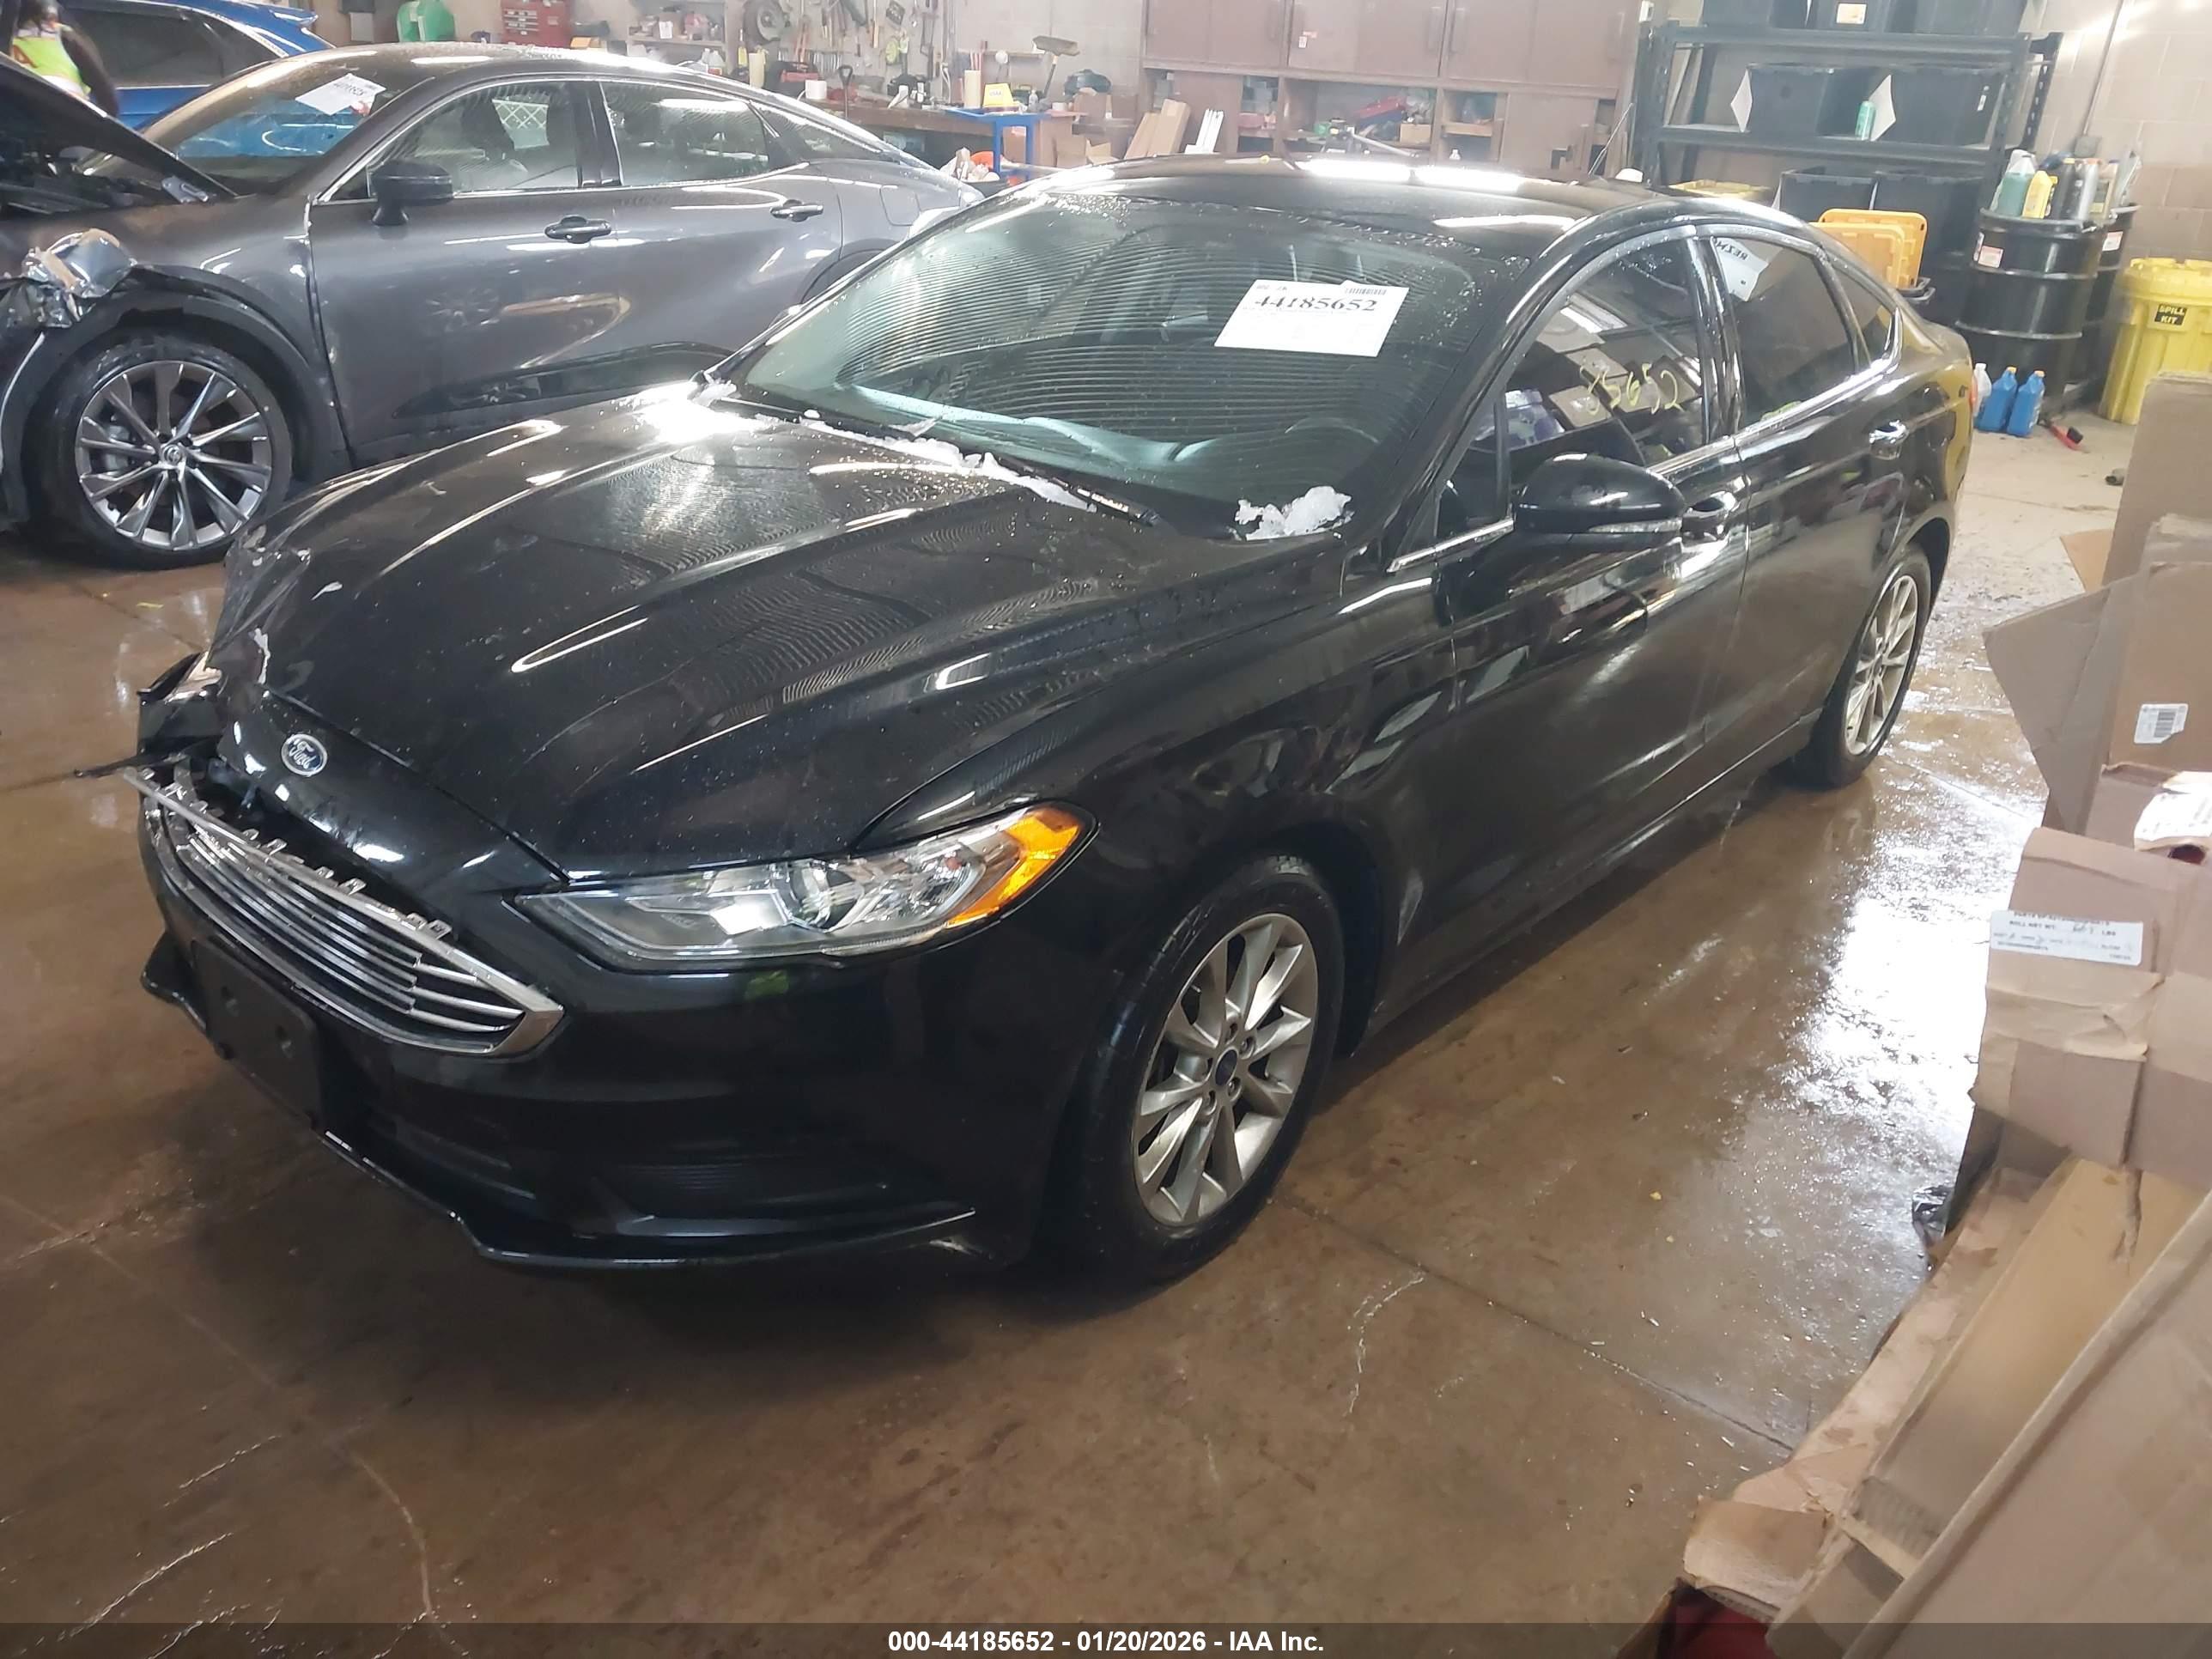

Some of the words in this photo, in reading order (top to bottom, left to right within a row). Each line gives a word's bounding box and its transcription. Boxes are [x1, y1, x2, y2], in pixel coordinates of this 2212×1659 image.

[1255, 295, 1378, 312] 44185652
[2159, 305, 2185, 316] SPILL
[2160, 315, 2179, 325] KIT
[289, 738, 317, 769] Ford
